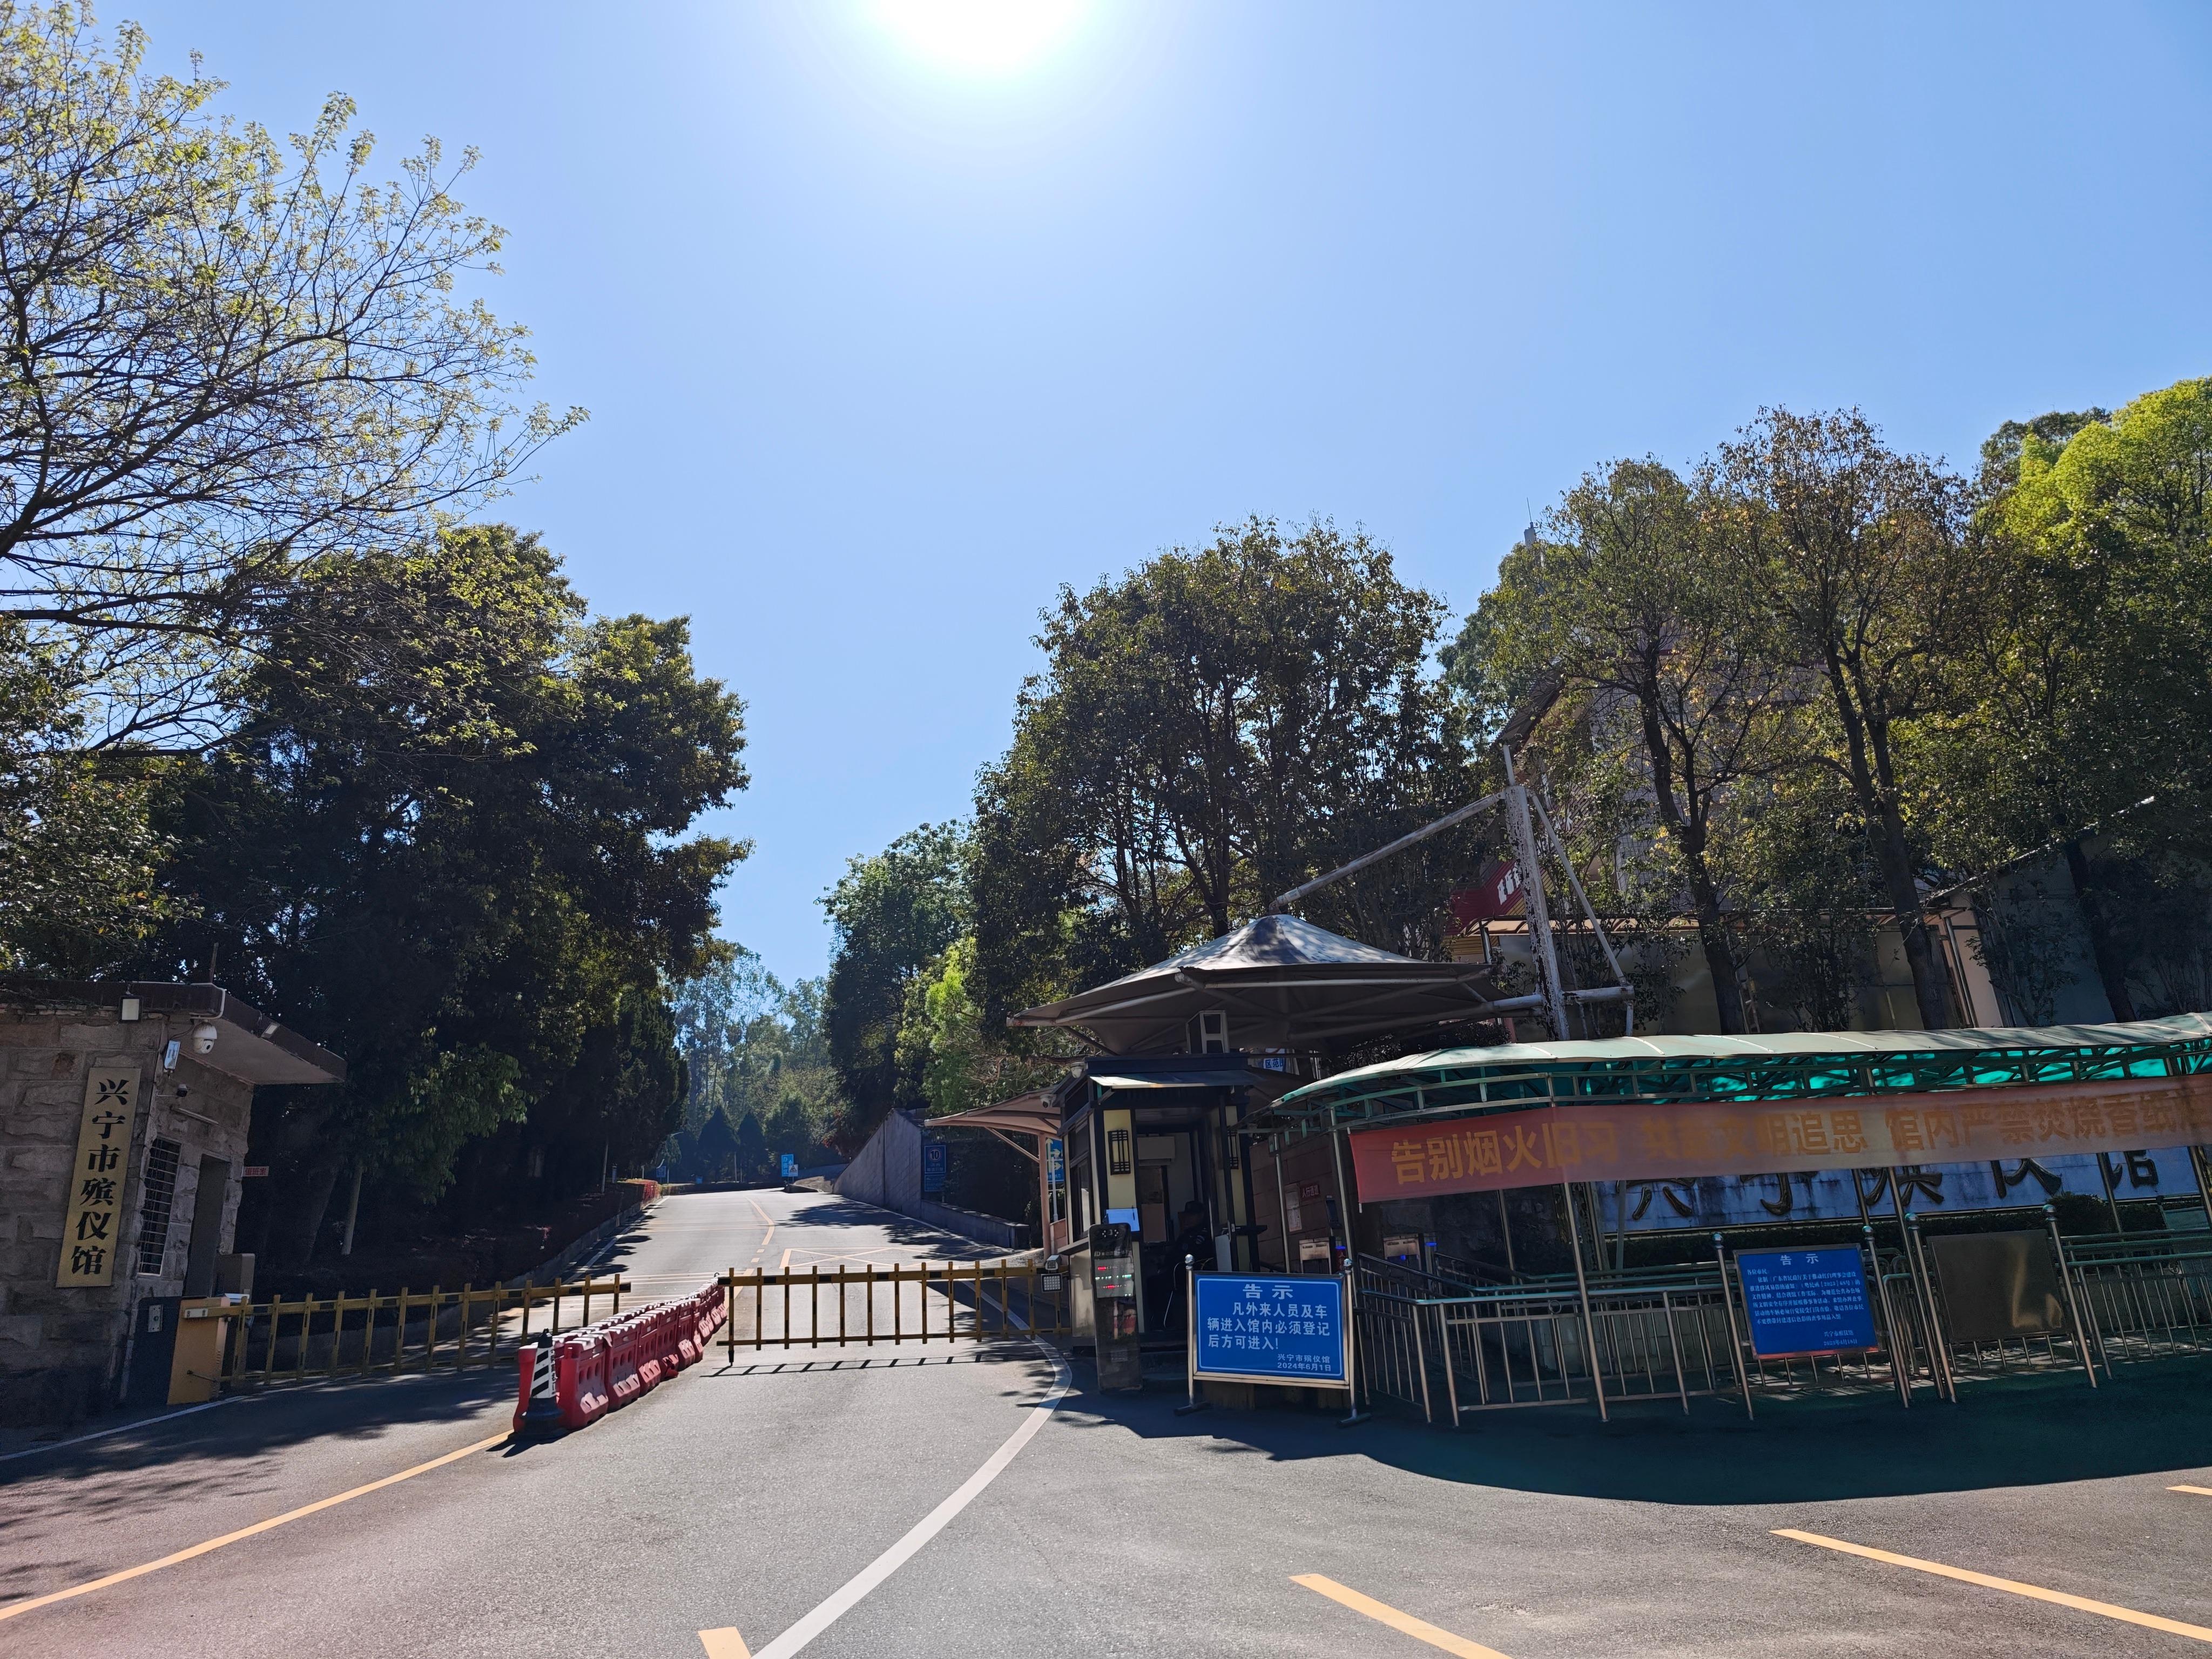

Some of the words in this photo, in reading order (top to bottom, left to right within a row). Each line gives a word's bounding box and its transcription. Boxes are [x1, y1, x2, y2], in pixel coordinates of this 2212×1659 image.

[1391, 1121, 1618, 1184] 告别烟火旧习
[71, 1078, 129, 1275] 兴宁市殡仪馆
[1780, 1253, 1819, 1265] 告示
[1243, 1284, 1293, 1299] 告示
[1232, 1302, 1327, 1319] 凡外来人员及车
[1207, 1317, 1330, 1336] 辆进入馆内必须登记
[1209, 1334, 1278, 1350] 后方可进入！
[1278, 1353, 1330, 1363] 兴宁市殡仪馆
[1277, 1363, 1331, 1371] 2024年6月1日
